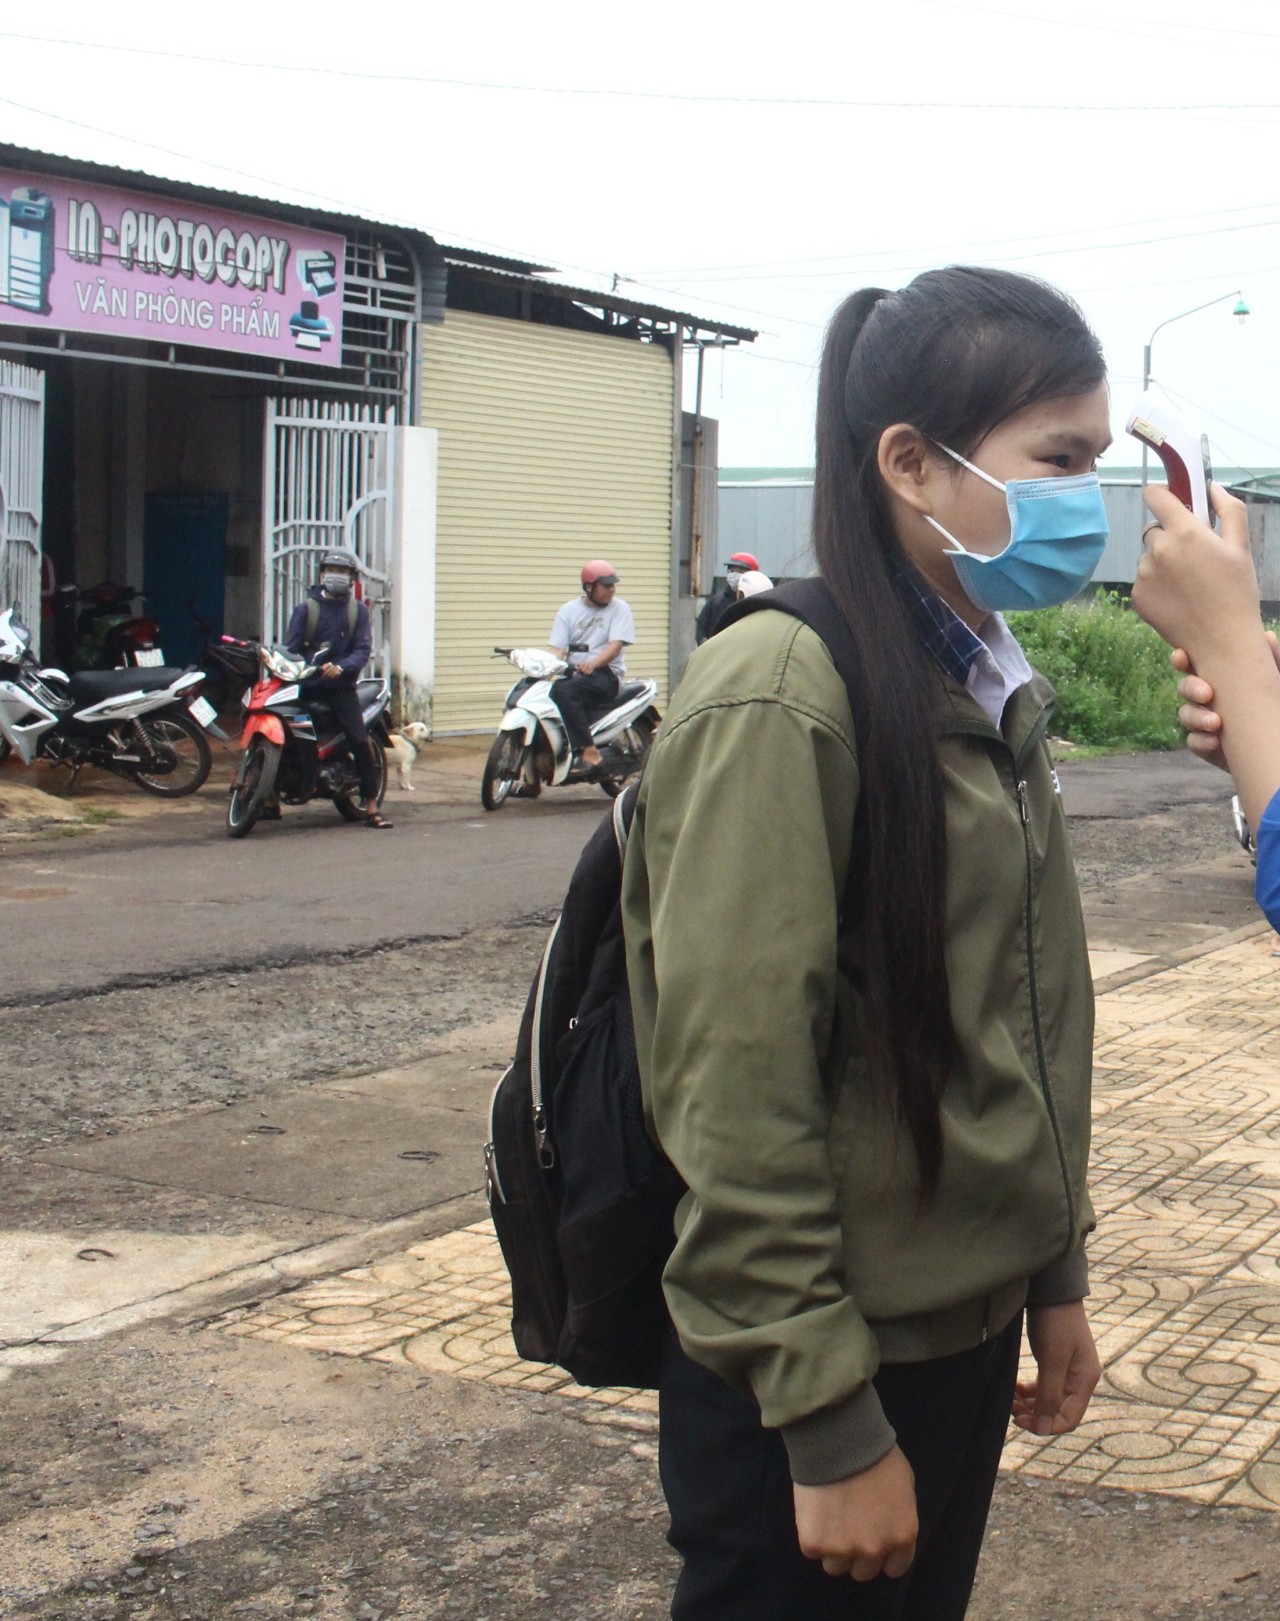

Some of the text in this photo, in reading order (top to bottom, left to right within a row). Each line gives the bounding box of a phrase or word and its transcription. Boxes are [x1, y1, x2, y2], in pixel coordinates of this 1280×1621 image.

[75, 277, 281, 340] VĂN PHÒNG PHẨM
